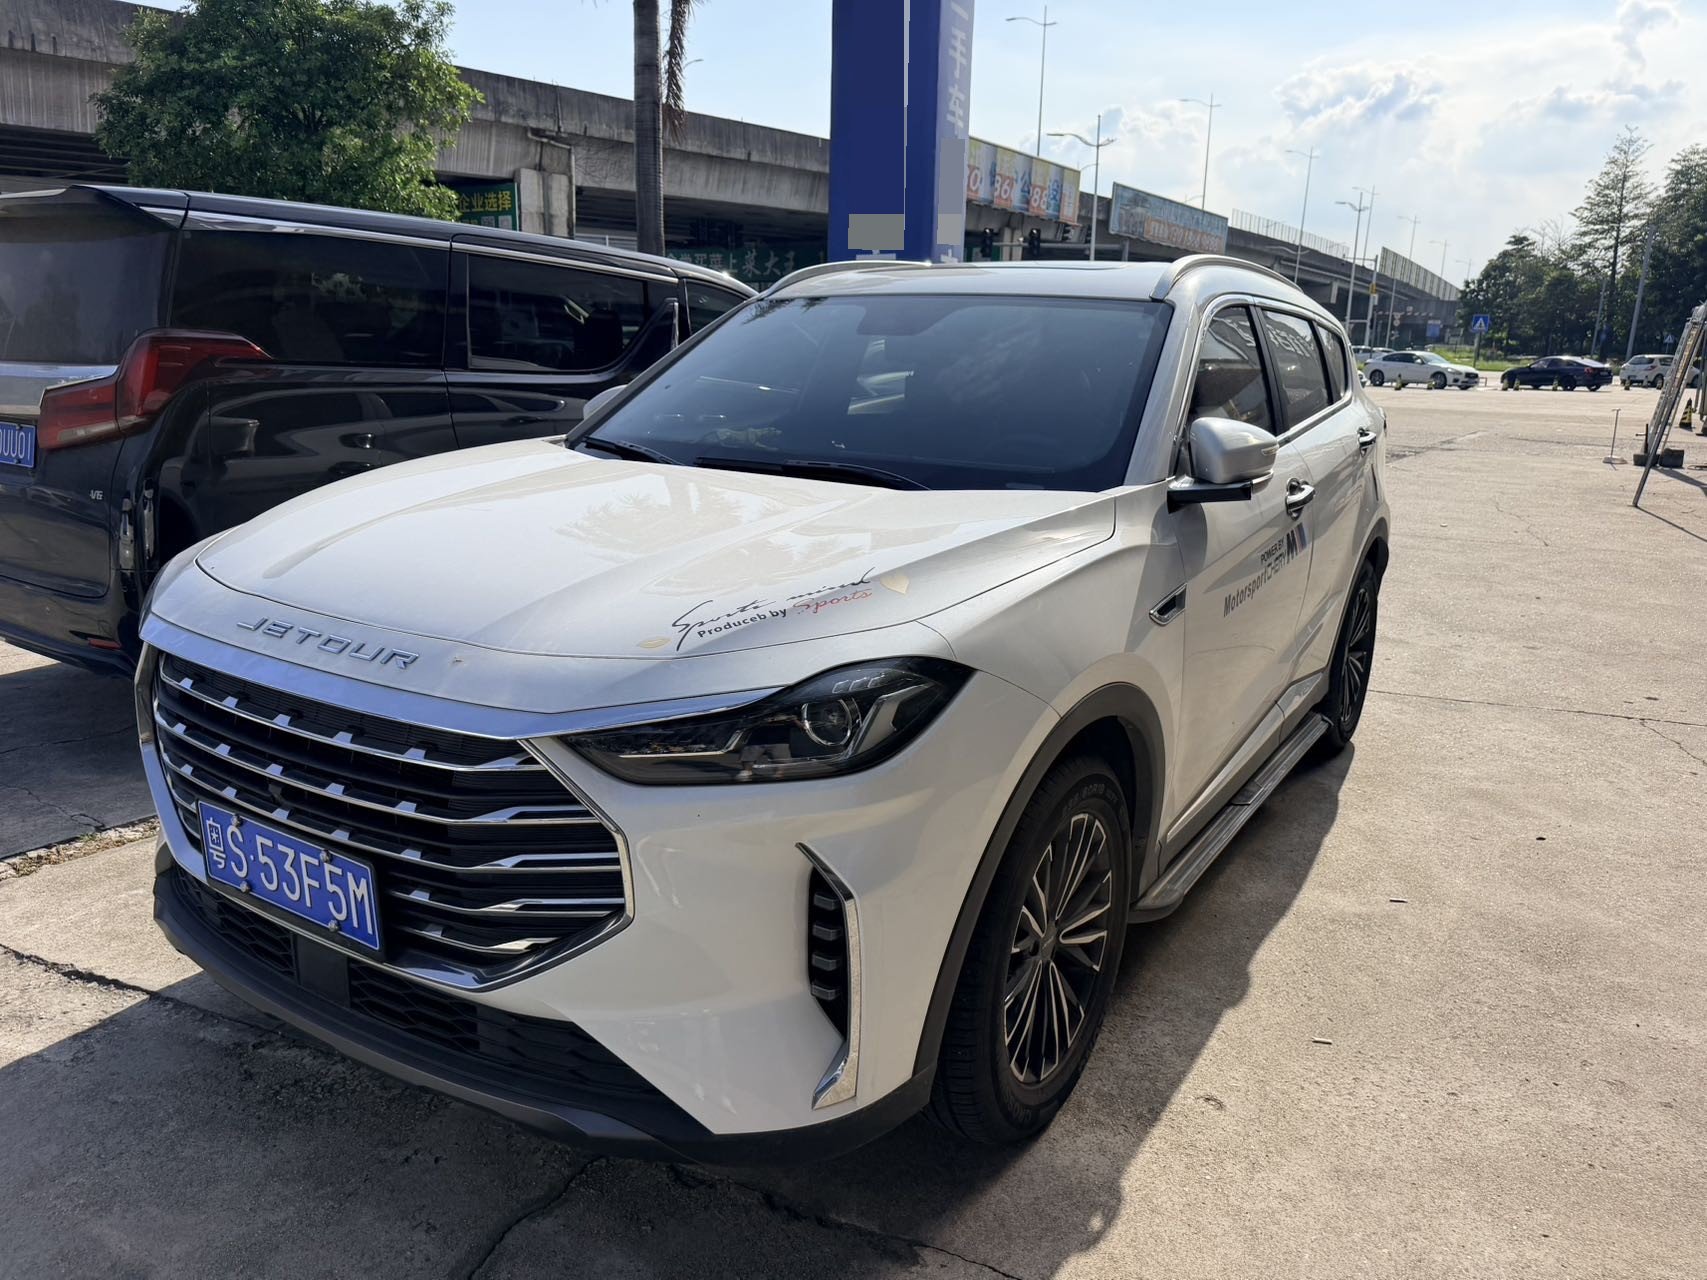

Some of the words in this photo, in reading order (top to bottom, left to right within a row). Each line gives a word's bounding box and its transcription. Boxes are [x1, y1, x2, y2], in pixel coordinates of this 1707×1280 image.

[459, 190, 512, 213] 企业选择
[768, 608, 787, 619] by
[792, 588, 873, 614] Sports
[1223, 566, 1267, 618] Motorsport
[236, 617, 420, 670] JETOUR
